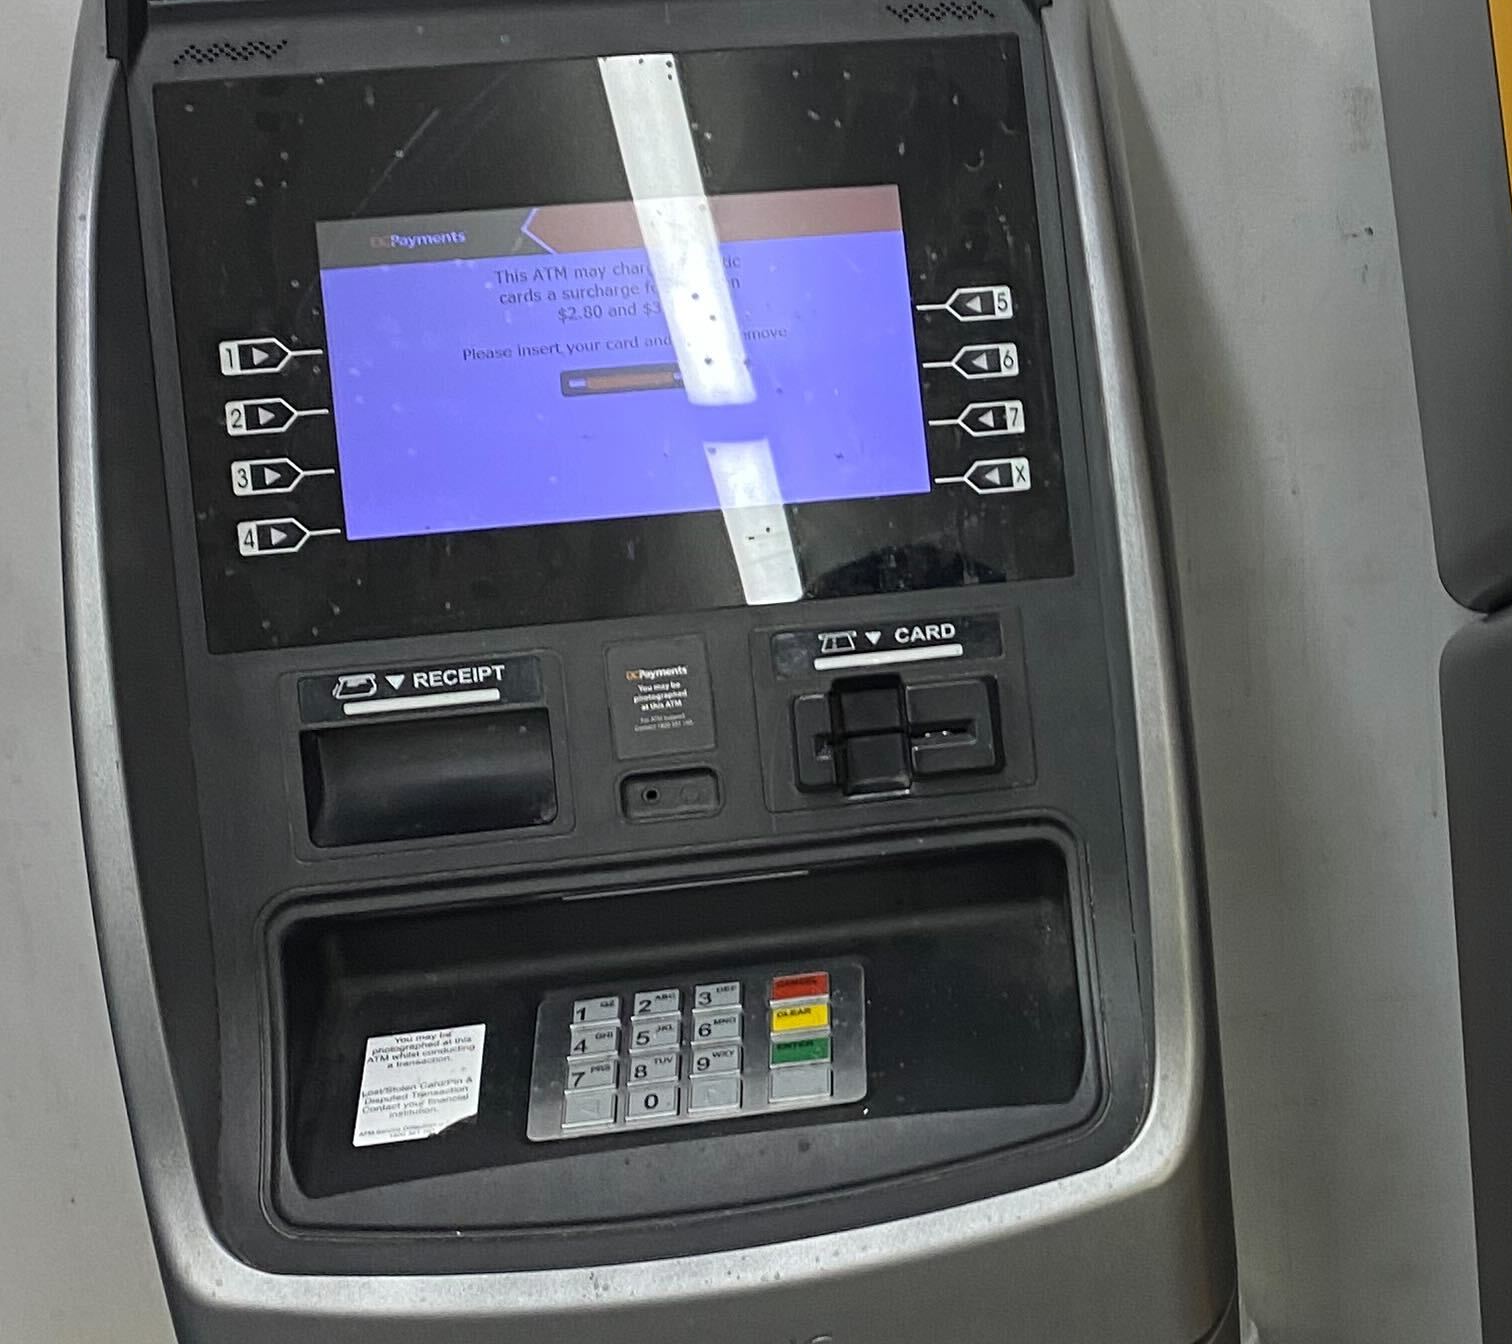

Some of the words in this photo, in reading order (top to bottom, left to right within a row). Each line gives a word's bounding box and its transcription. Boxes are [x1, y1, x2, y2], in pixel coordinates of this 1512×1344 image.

[495, 269, 528, 285] This
[533, 265, 567, 282] ATM
[574, 264, 606, 280] may
[500, 288, 541, 305] cards
[548, 290, 556, 302] a
[562, 283, 640, 303] surcharge
[997, 292, 1008, 311] 5
[558, 304, 603, 324] $2.80
[607, 302, 637, 318] and
[463, 346, 512, 361] Please
[518, 342, 562, 357] insert
[566, 339, 604, 357] your
[606, 334, 639, 351] card
[225, 348, 233, 368] 1
[1003, 350, 1014, 369] 6
[231, 408, 243, 429] 2
[1009, 408, 1018, 426] 7
[237, 468, 248, 488] 3
[1015, 465, 1026, 482] X
[243, 528, 255, 548] 4
[894, 623, 957, 644] CARD
[412, 664, 505, 689] RECEIPT
[638, 683, 652, 693] You
[665, 698, 683, 709] ATM
[698, 991, 712, 1005] 3
[638, 999, 652, 1013] 2
[777, 1007, 811, 1018] CLEAR
[576, 1007, 586, 1021] 1
[698, 1023, 712, 1037] 6
[395, 1037, 413, 1045] You
[636, 1031, 651, 1045] 5
[573, 1039, 587, 1053] 4
[367, 1054, 389, 1064] ATM
[697, 1057, 711, 1071] 9
[634, 1064, 648, 1079] 8
[572, 1072, 586, 1087] 7
[644, 1094, 659, 1109] 0
